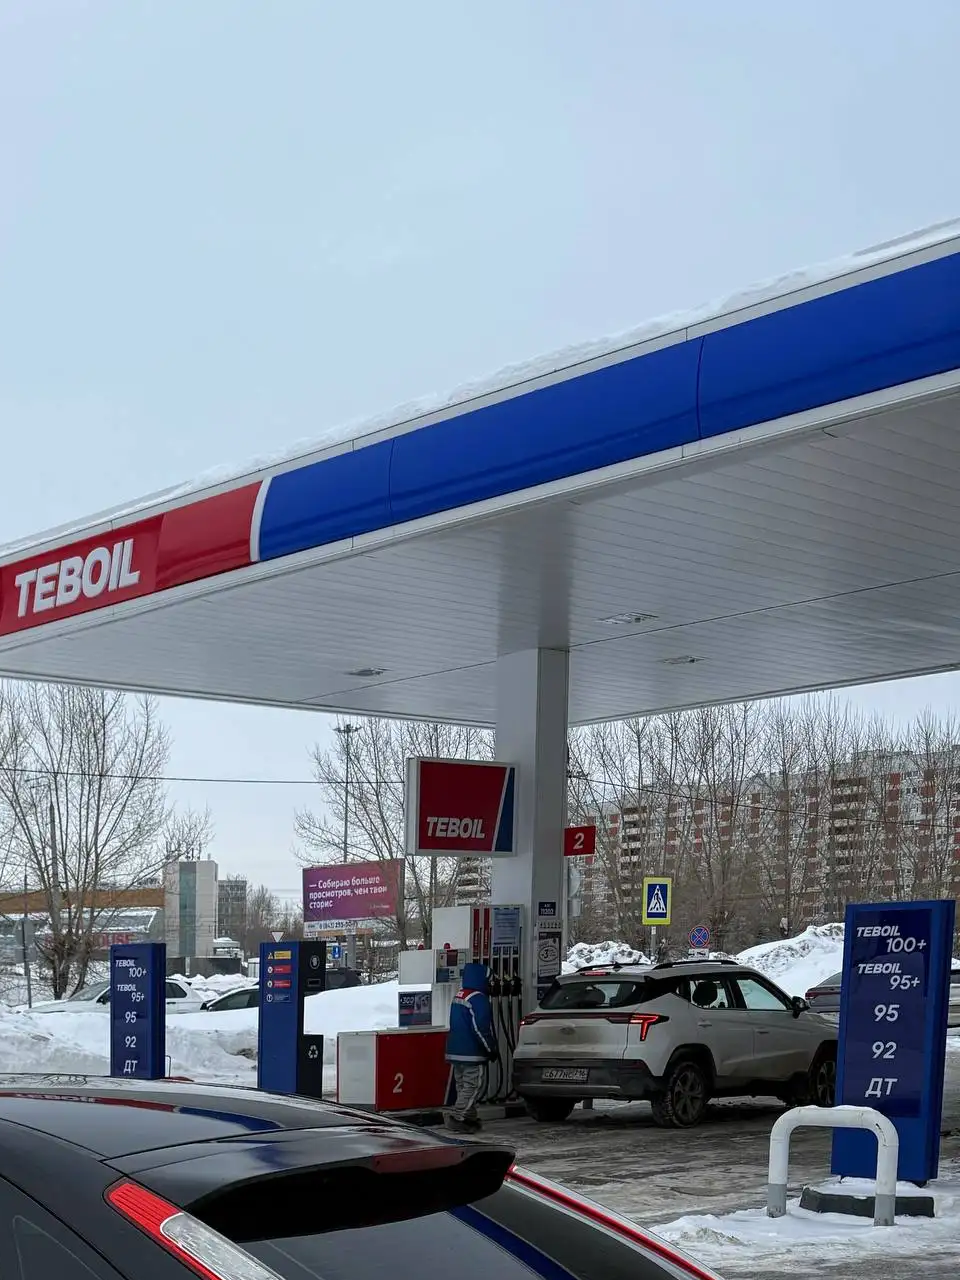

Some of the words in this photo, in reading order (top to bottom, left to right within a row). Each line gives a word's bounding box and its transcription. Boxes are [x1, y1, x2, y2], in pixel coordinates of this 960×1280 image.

[14, 538, 141, 618] TEBOIL
[426, 816, 485, 839] TEBOIL
[573, 832, 585, 850] 2
[318, 878, 351, 889] Собираю
[352, 876, 381, 886] больше
[309, 900, 333, 909] сторис
[856, 925, 901, 937] TEBOIL
[886, 937, 927, 952] 100+
[115, 959, 136, 967] TEBOIL
[858, 963, 902, 974] TEBOIL
[129, 967, 147, 978] 100+
[117, 984, 137, 992] TEBOIL
[890, 975, 920, 990] 95+
[131, 992, 145, 1002] 95+
[125, 1011, 137, 1023] 95
[874, 1004, 900, 1022] 95
[125, 1036, 137, 1048] 92
[872, 1041, 897, 1059] 92
[123, 1060, 138, 1074] ДТ
[393, 1072, 404, 1094] 2
[864, 1078, 898, 1098] ДТ
